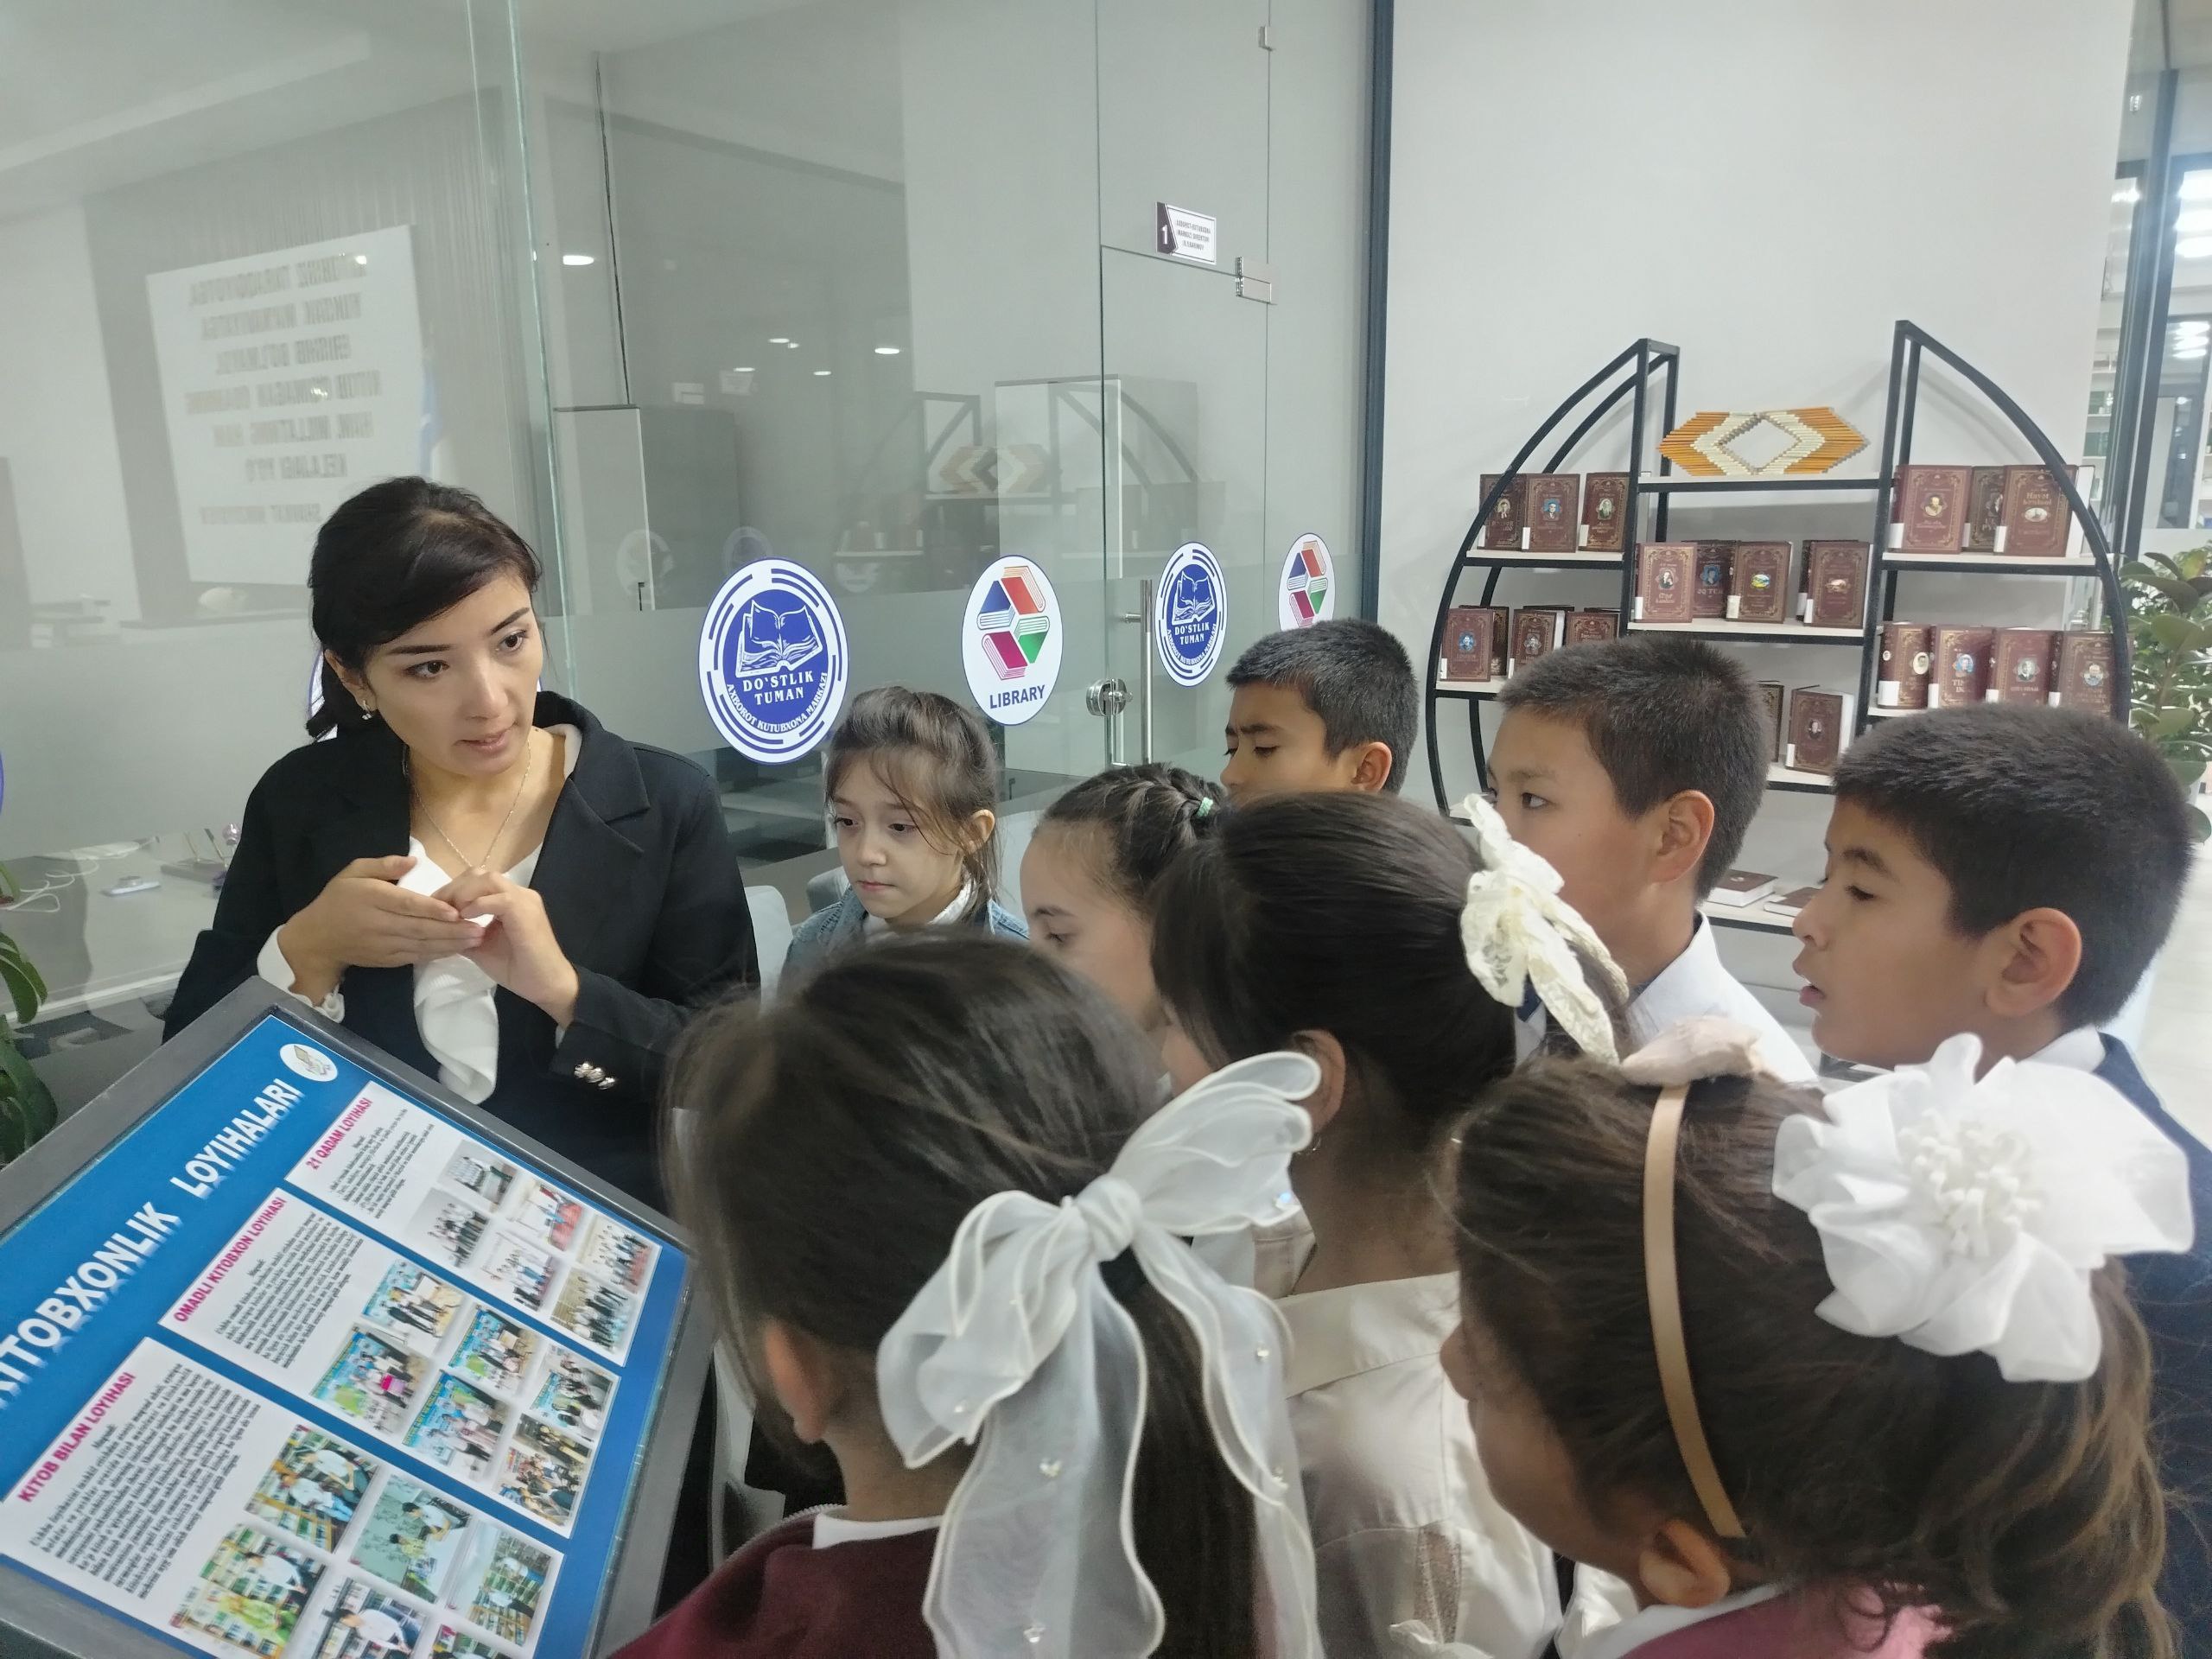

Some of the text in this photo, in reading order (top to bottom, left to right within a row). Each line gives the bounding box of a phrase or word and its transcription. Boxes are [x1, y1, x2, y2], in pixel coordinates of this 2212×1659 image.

[1162, 225, 1168, 245] 1
[1175, 622, 1209, 635] DO'STLIK
[1180, 633, 1205, 645] TUMAN
[743, 671, 814, 692] DO'STLIK
[727, 672, 828, 733] AXBOROT KUTUBXONA MARKAZI
[754, 687, 804, 705] TUMAN
[989, 684, 1046, 709] LIBRARY
[169, 1077, 304, 1198] LOYIHALARI
[306, 1097, 372, 1170] 21 QADAM LOYIHASI
[174, 1197, 287, 1322] OMADLI KITOBXON LOYIHASI
[17, 1461, 60, 1502] KITOB
[53, 1423, 92, 1461] BILAN
[85, 1372, 136, 1424] LOYIHASI
